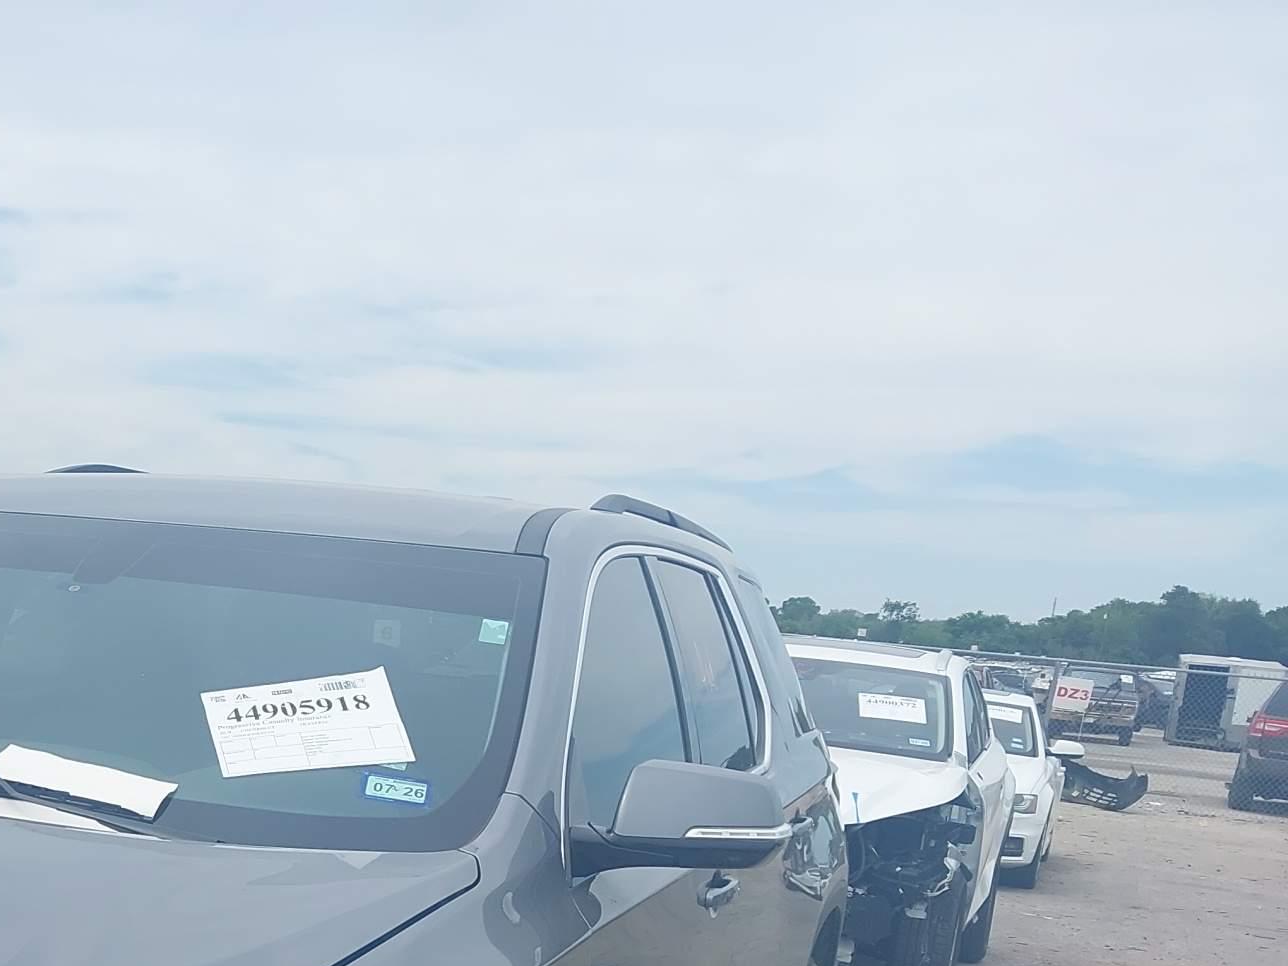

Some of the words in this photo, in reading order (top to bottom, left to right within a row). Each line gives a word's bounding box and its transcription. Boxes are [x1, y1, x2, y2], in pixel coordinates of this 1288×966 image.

[1056, 685, 1090, 701] DZ3
[226, 694, 371, 722] 44905918
[373, 782, 393, 794] 07
[403, 787, 425, 799] 26
